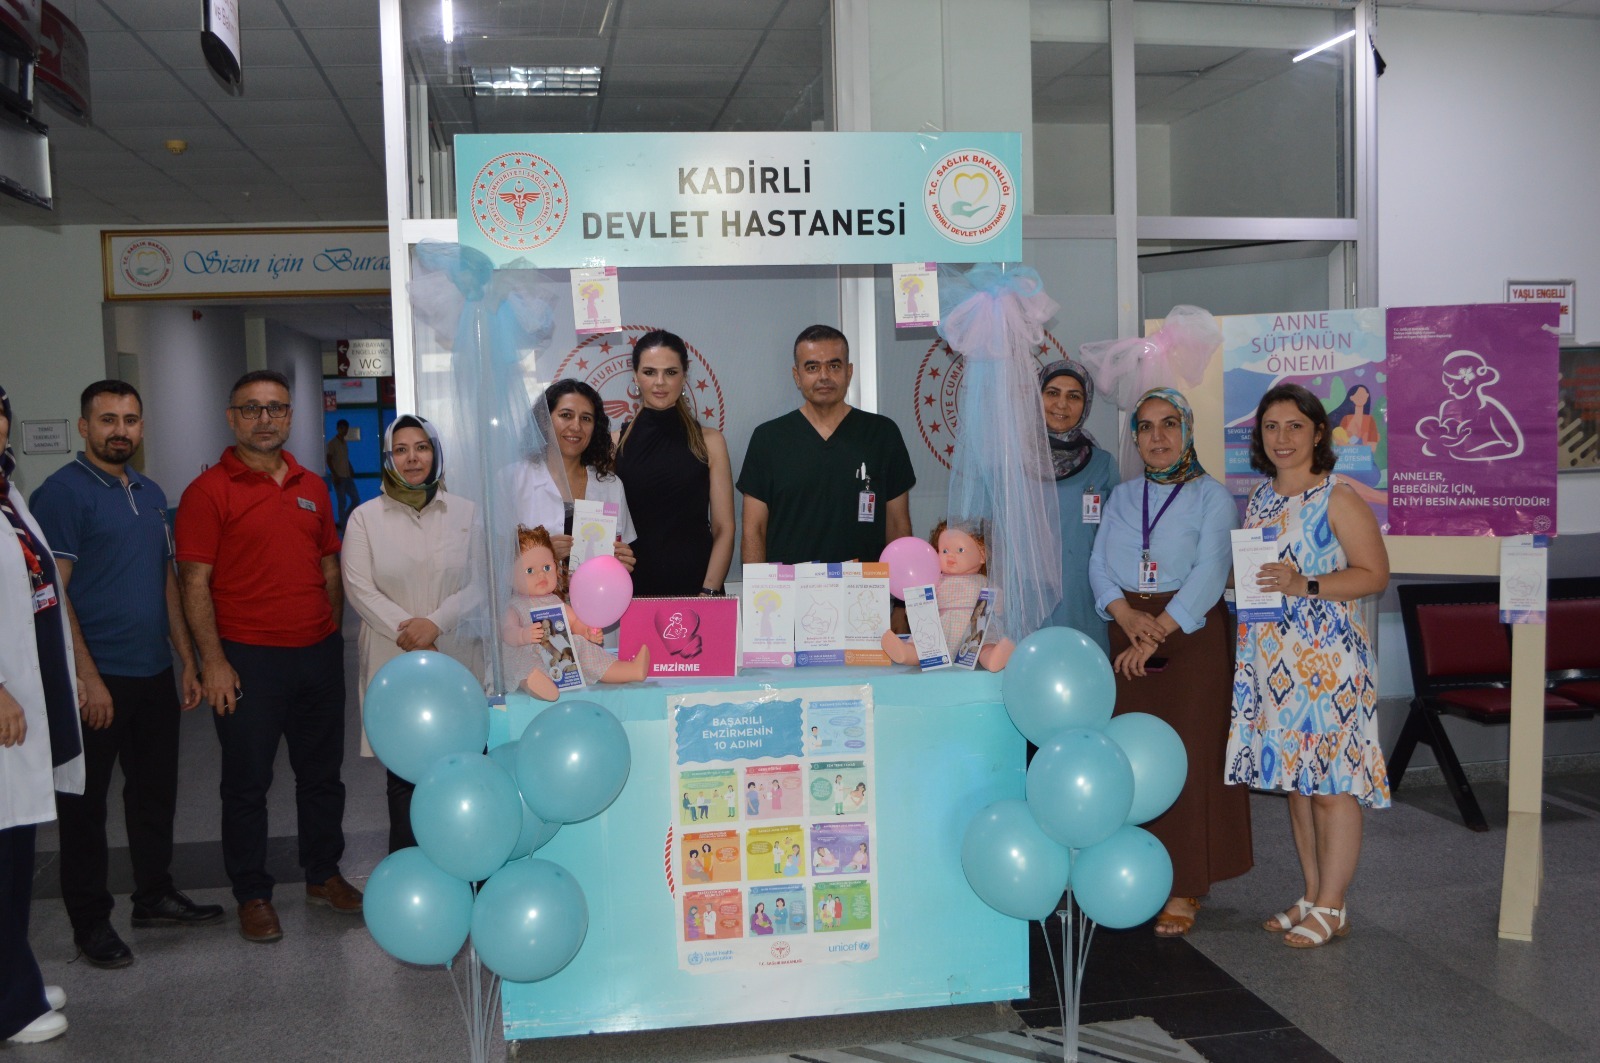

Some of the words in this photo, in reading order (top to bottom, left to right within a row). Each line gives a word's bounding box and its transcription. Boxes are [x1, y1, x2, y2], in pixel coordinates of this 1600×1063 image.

[678, 160, 811, 195] KADİRLİ
[936, 154, 970, 177] SAĞLIK
[972, 155, 1010, 196] BAKANLIĞI
[582, 211, 709, 240] DEVLET
[722, 201, 906, 238] HASTANESİ
[931, 203, 952, 230] KADİRLİ
[950, 226, 978, 237] DEVLET
[978, 203, 1007, 236] HASTANESİ
[183, 250, 260, 274] Sizin
[267, 253, 304, 279] için
[1272, 312, 1329, 332] ANNE
[1251, 331, 1351, 353] SÜTÜNÜN
[359, 358, 382, 370] WC
[1266, 351, 1335, 373] ÖNEMİ
[1392, 472, 1446, 482] ANNELER,
[1392, 483, 1448, 494] BEBEĞİNİZ
[1451, 483, 1476, 495] İÇİN,
[1392, 498, 1407, 506] EN
[1409, 496, 1423, 506] İYİ
[1425, 496, 1457, 506] BESİN
[1459, 497, 1490, 506] ANNE
[1492, 495, 1550, 506] SÜTÜDÜR!
[653, 662, 700, 672] EMZİRME
[712, 715, 762, 728] BAŞARILI
[702, 725, 773, 739] EMZİRMENİN
[714, 741, 727, 750] 10
[730, 739, 762, 749] ADIMI
[828, 941, 858, 953] unicef
